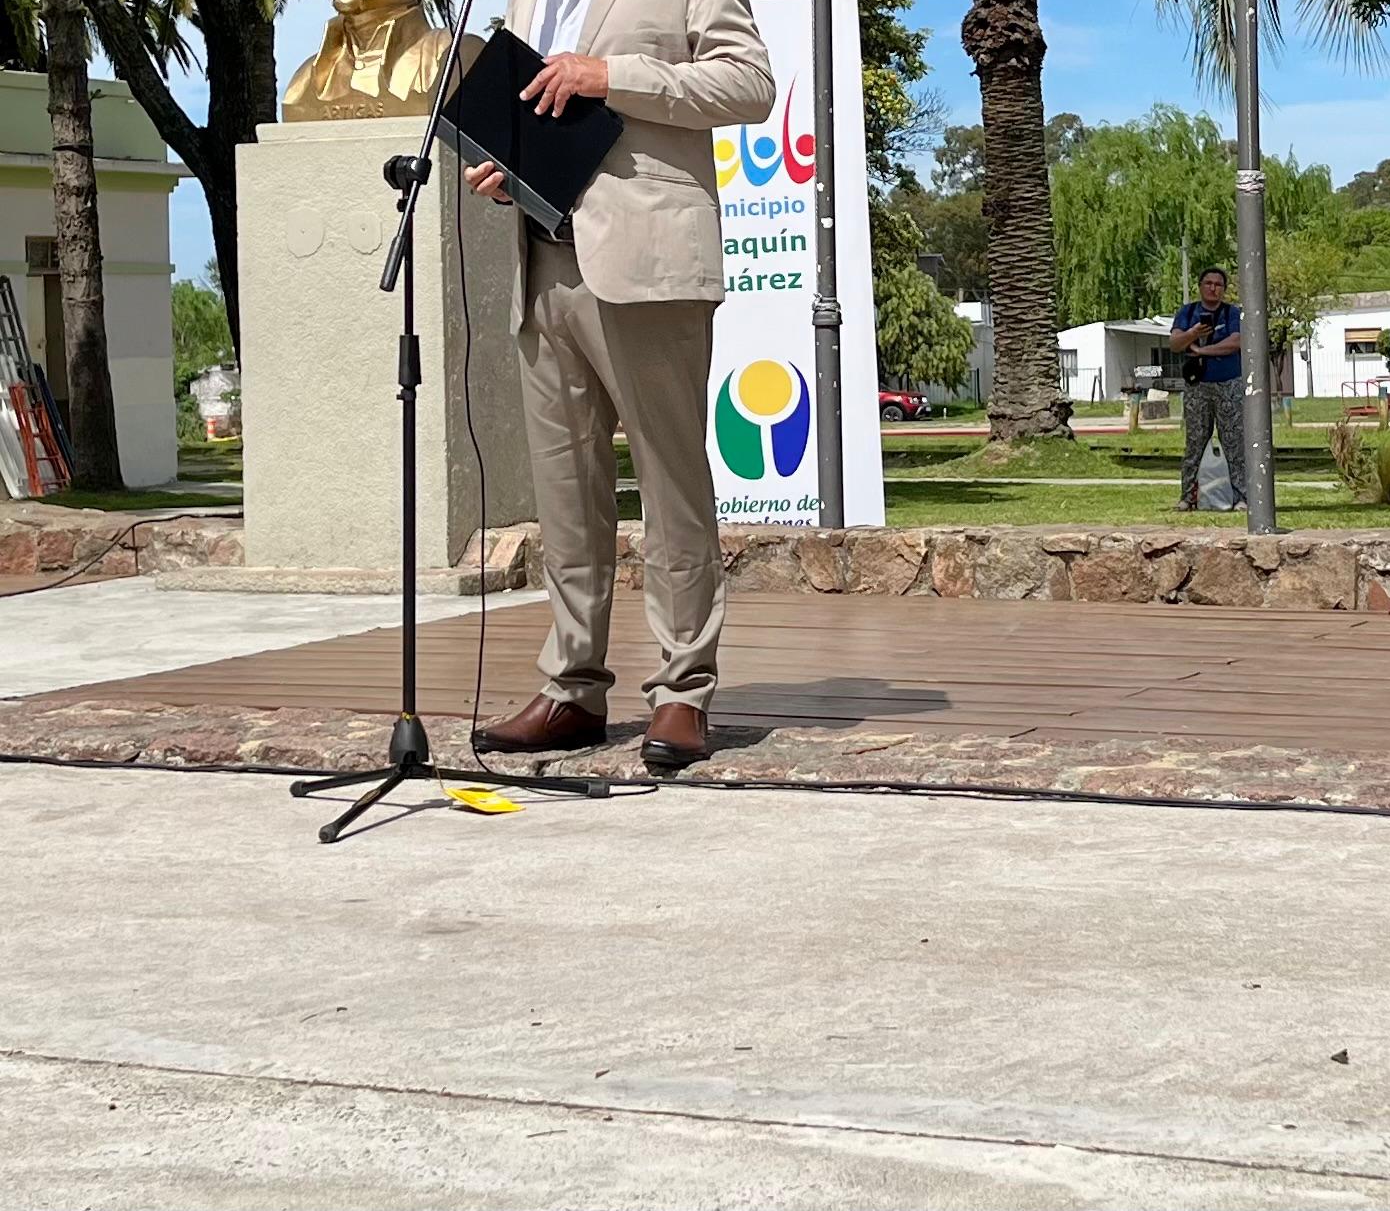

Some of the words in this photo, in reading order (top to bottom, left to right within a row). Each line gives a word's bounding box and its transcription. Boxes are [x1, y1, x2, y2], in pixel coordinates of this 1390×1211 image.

[720, 196, 805, 220] nicipio
[723, 228, 807, 259] aquín
[724, 267, 803, 292] uárez
[796, 494, 822, 511] de
